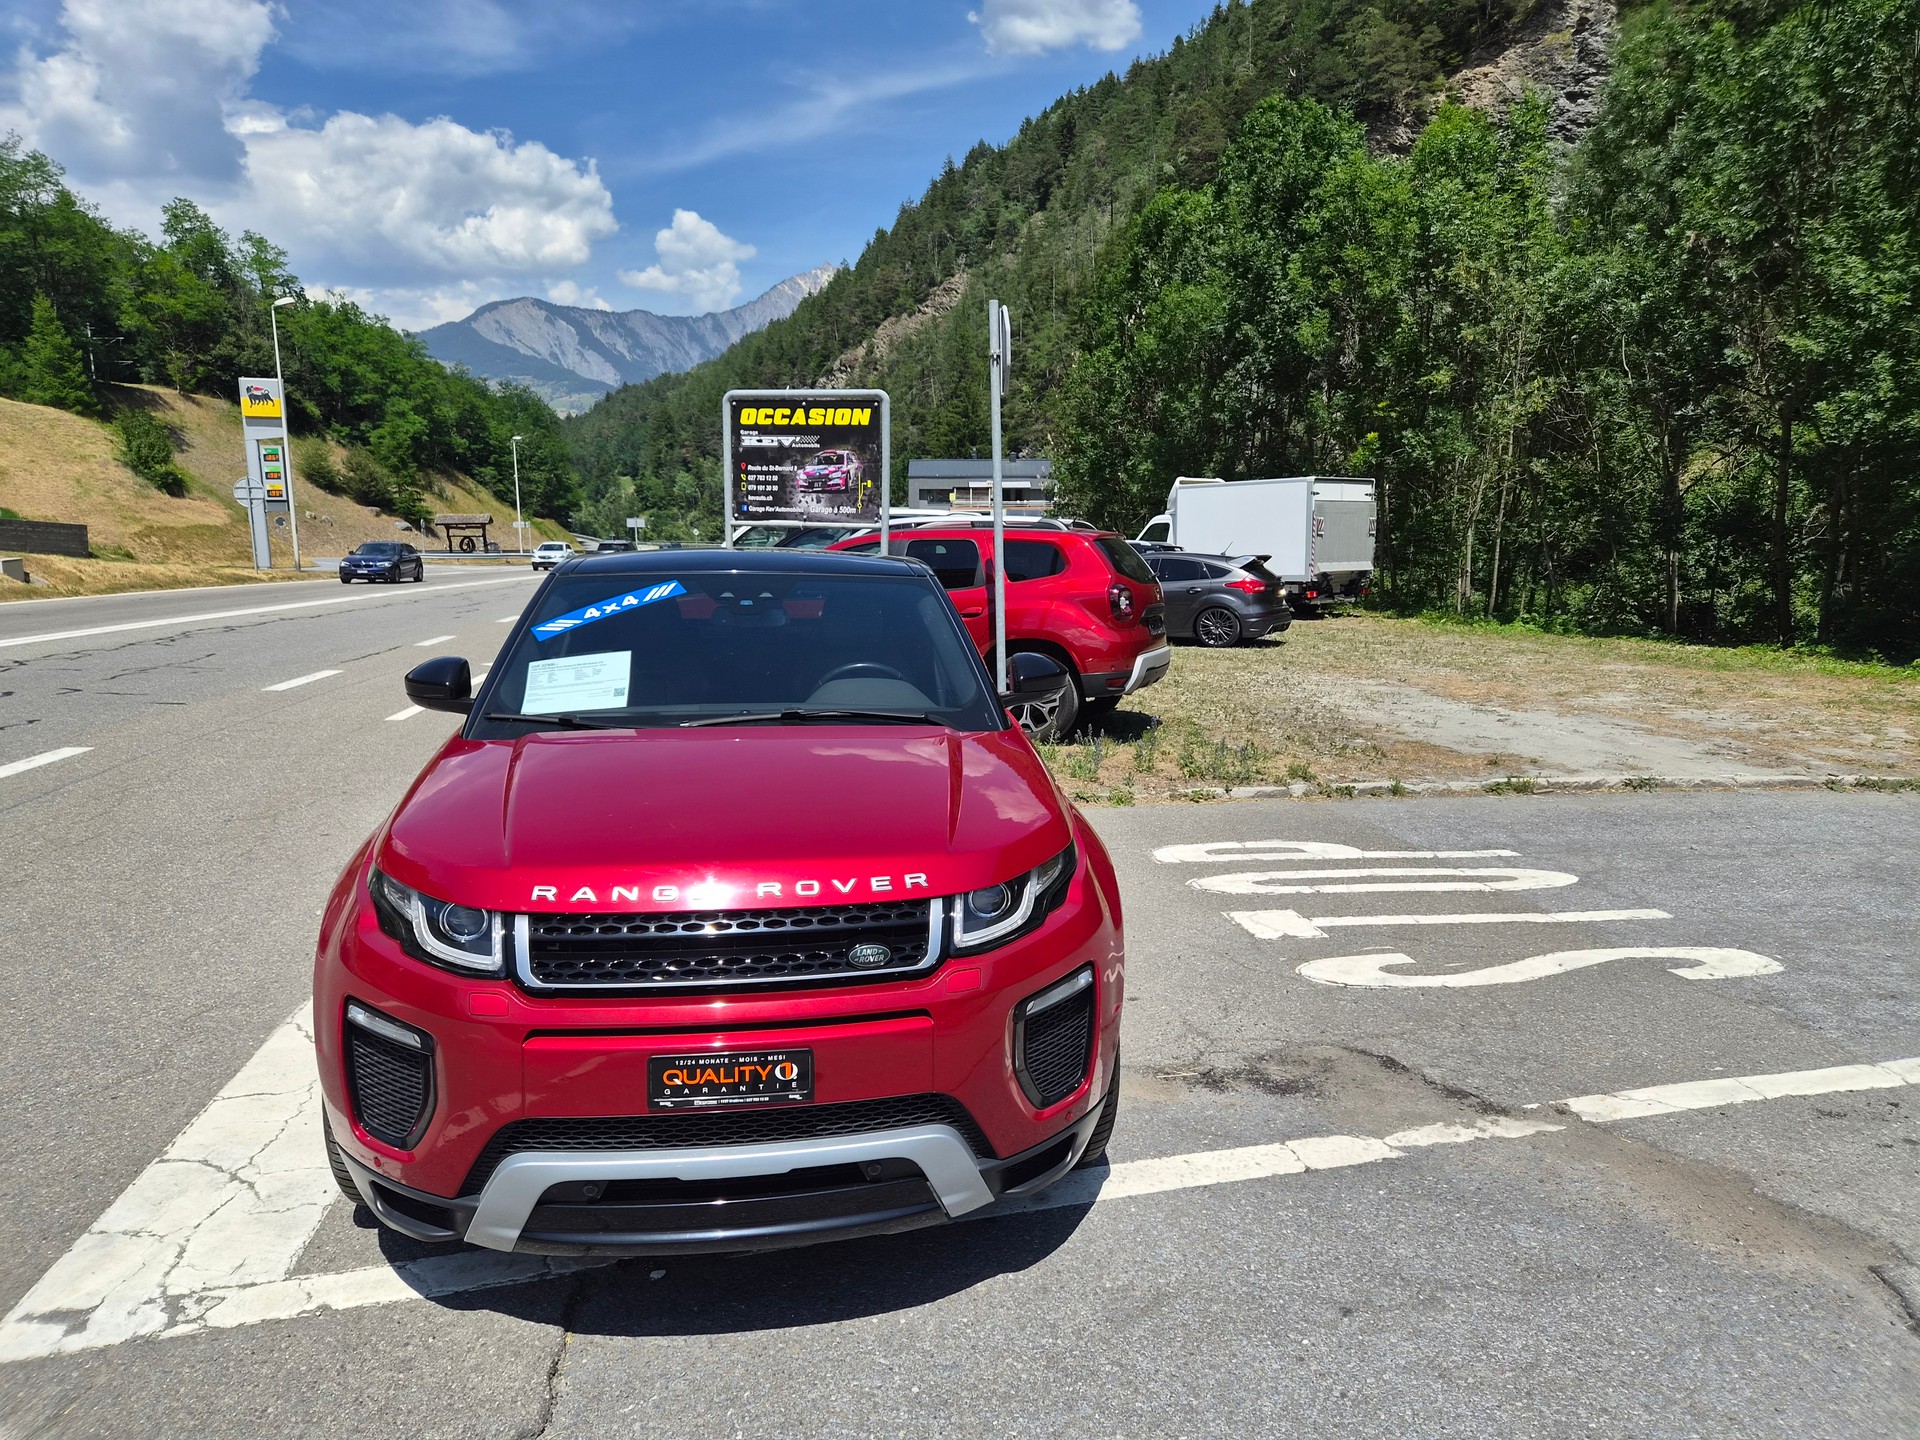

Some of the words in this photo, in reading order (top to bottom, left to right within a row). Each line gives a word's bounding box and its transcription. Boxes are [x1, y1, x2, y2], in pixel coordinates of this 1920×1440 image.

[740, 408, 871, 426] OCCASION
[748, 505, 766, 513] Garage
[810, 505, 833, 514] Garage
[839, 505, 857, 514] 500m
[583, 595, 640, 619] 4x4
[530, 884, 718, 903] RANG
[757, 872, 929, 898] ROVER
[1150, 840, 1785, 989] STOP
[858, 954, 884, 963] ROVER
[699, 1057, 729, 1065] MONATE
[662, 1064, 773, 1086] QUALITY
[664, 1081, 797, 1095] GARANTIE
